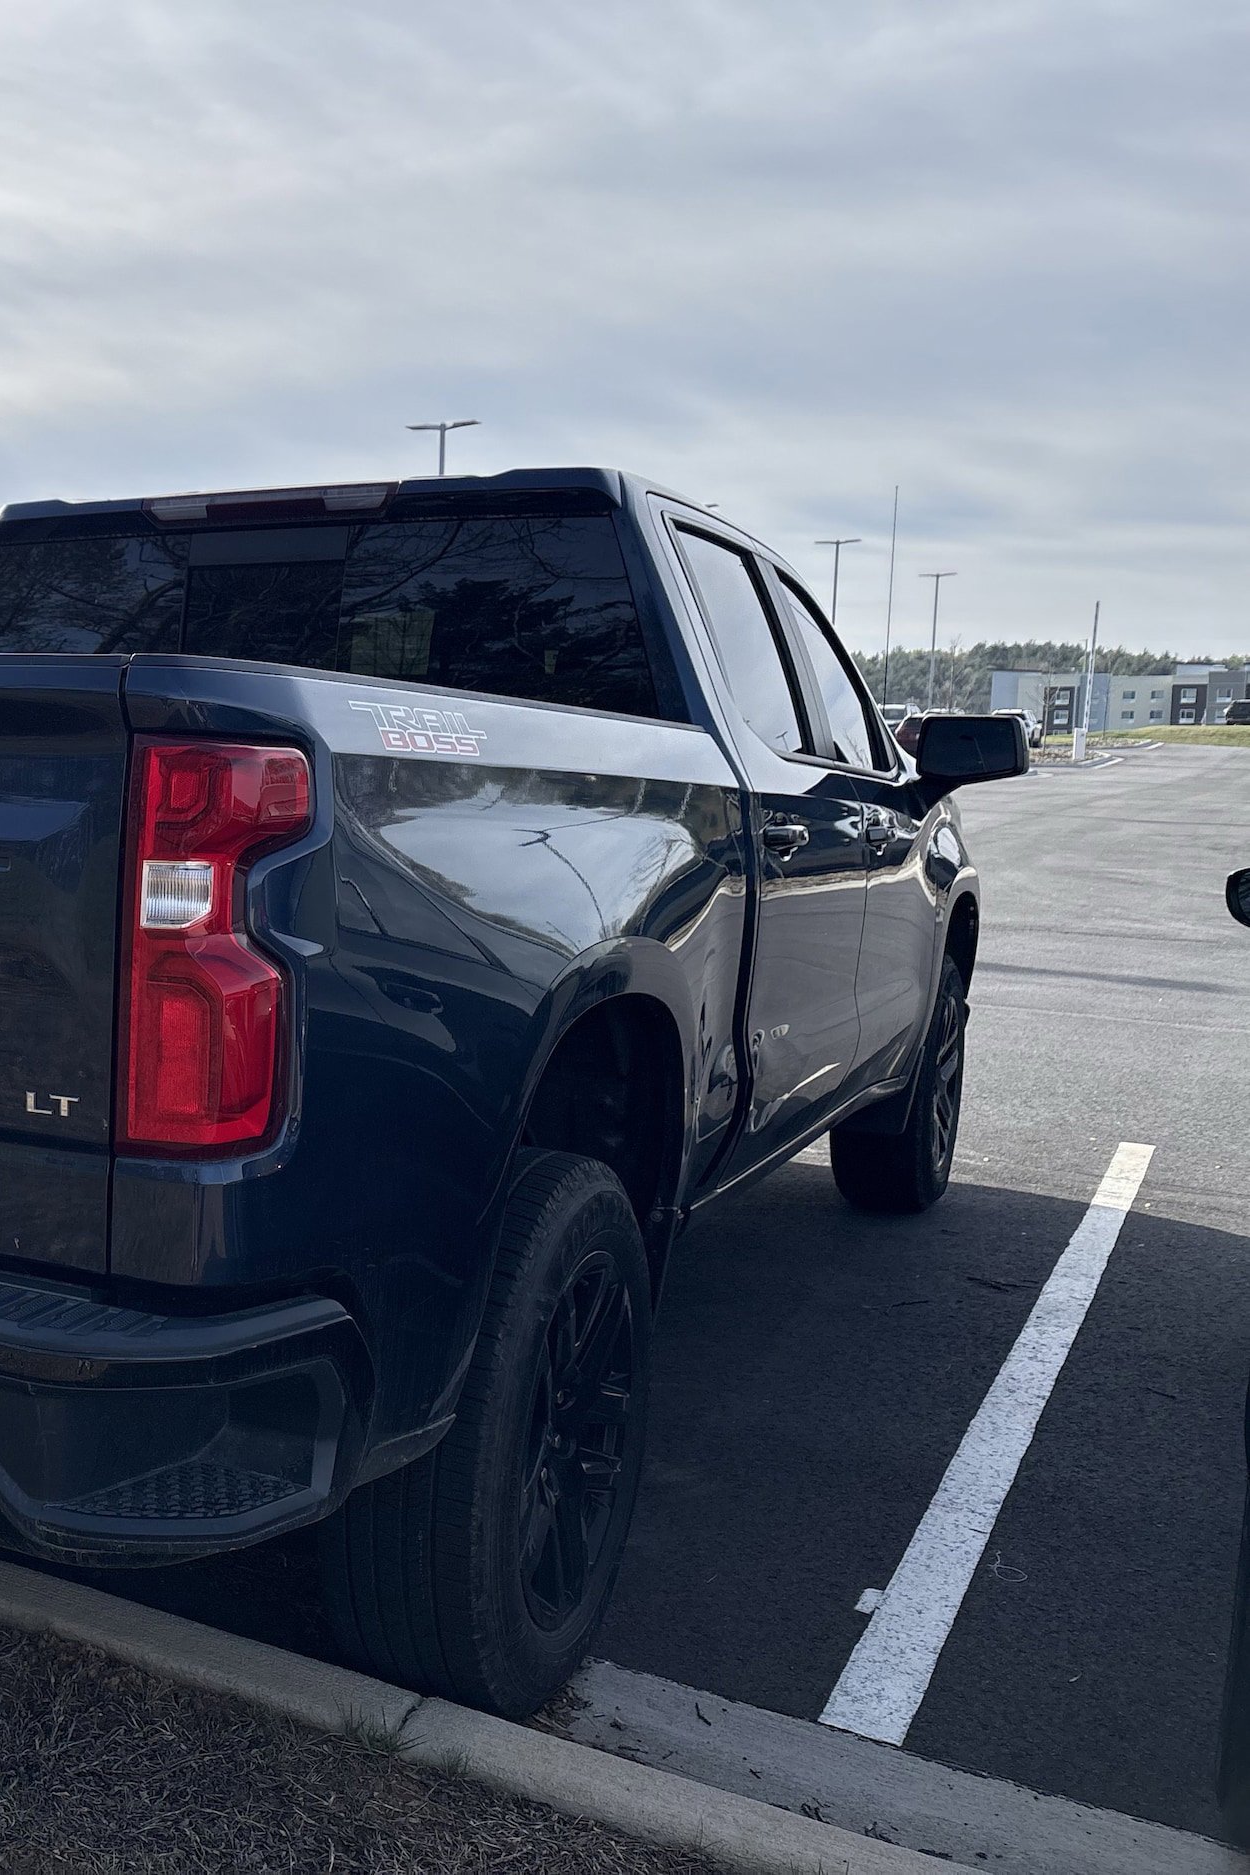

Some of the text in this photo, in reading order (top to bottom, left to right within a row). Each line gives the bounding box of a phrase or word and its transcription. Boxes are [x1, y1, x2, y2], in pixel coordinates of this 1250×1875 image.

[348, 700, 488, 740] TRAIL
[380, 728, 480, 757] BOSS
[25, 1090, 80, 1117] LT
